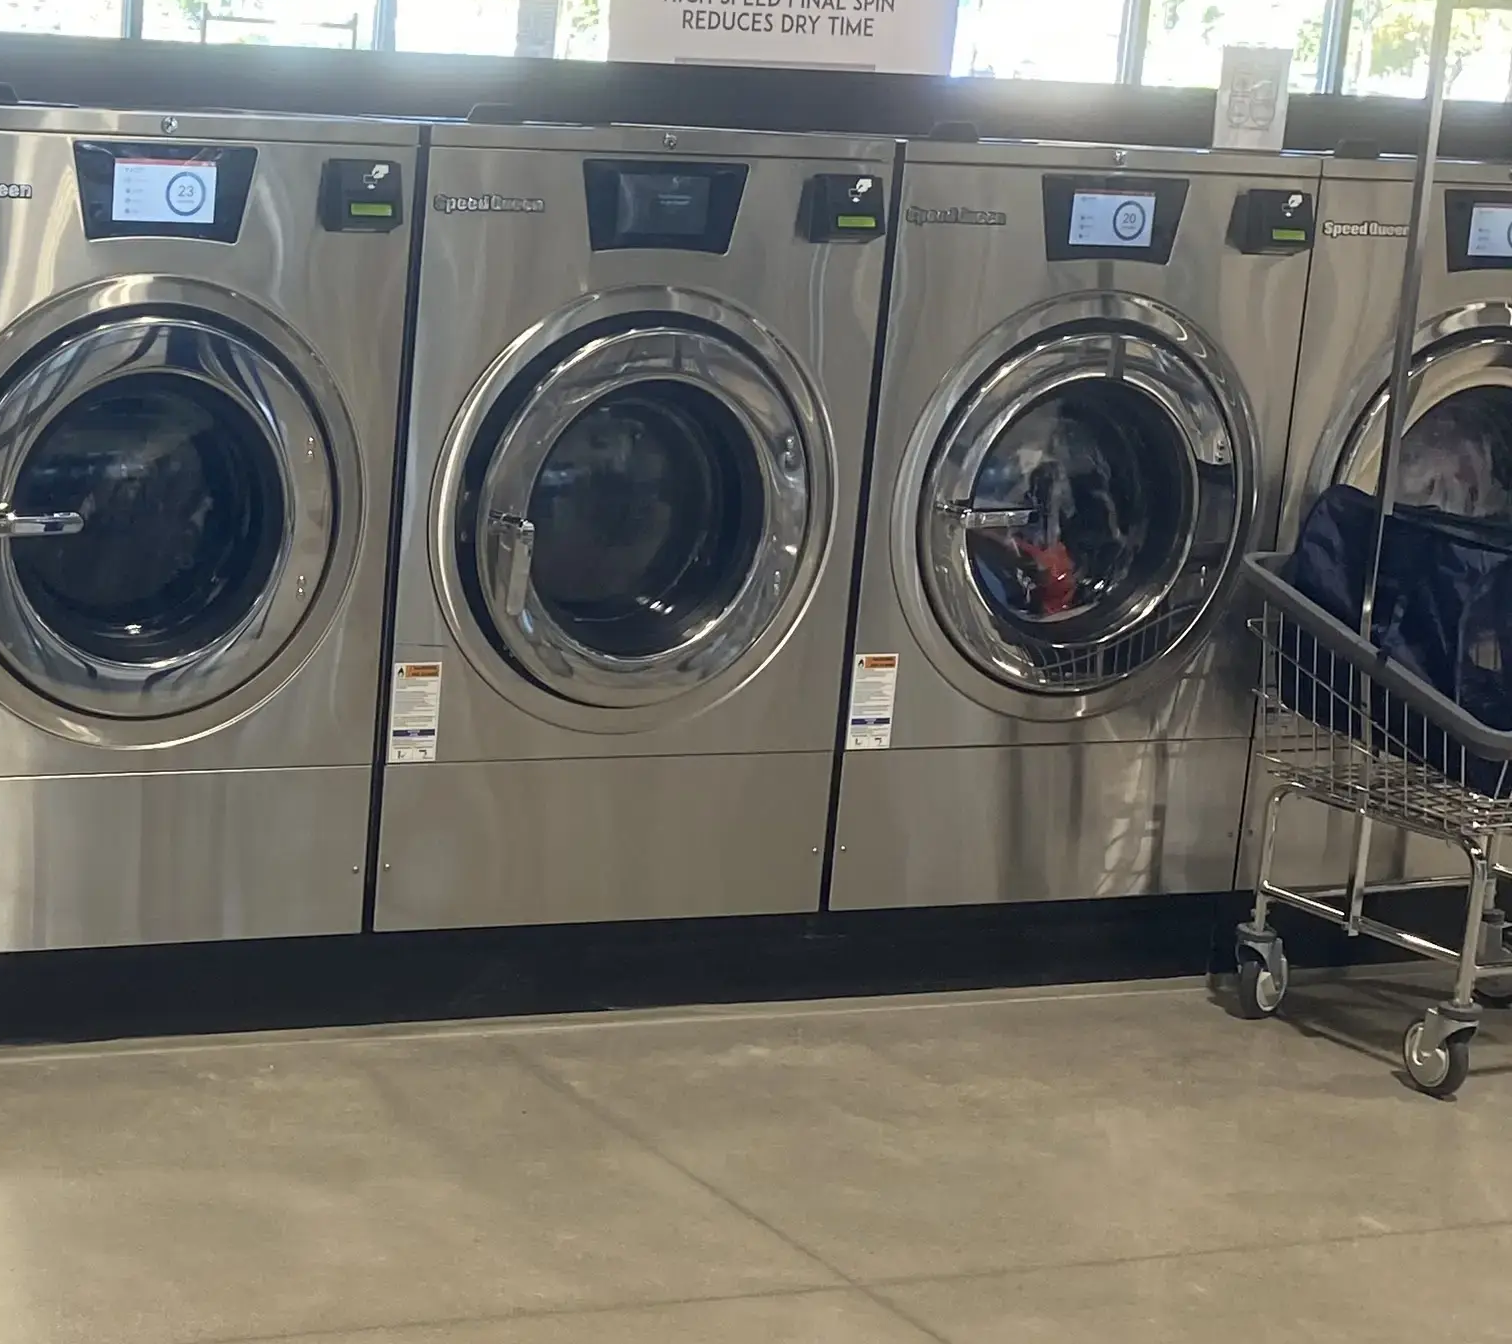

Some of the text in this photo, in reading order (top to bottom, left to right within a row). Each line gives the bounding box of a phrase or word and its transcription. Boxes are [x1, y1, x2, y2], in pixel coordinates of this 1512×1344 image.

[682, 10, 875, 37] REDUCES DRY TIME
[178, 185, 194, 197] 23
[1122, 213, 1137, 224] 20
[1323, 220, 1368, 238] Speed
